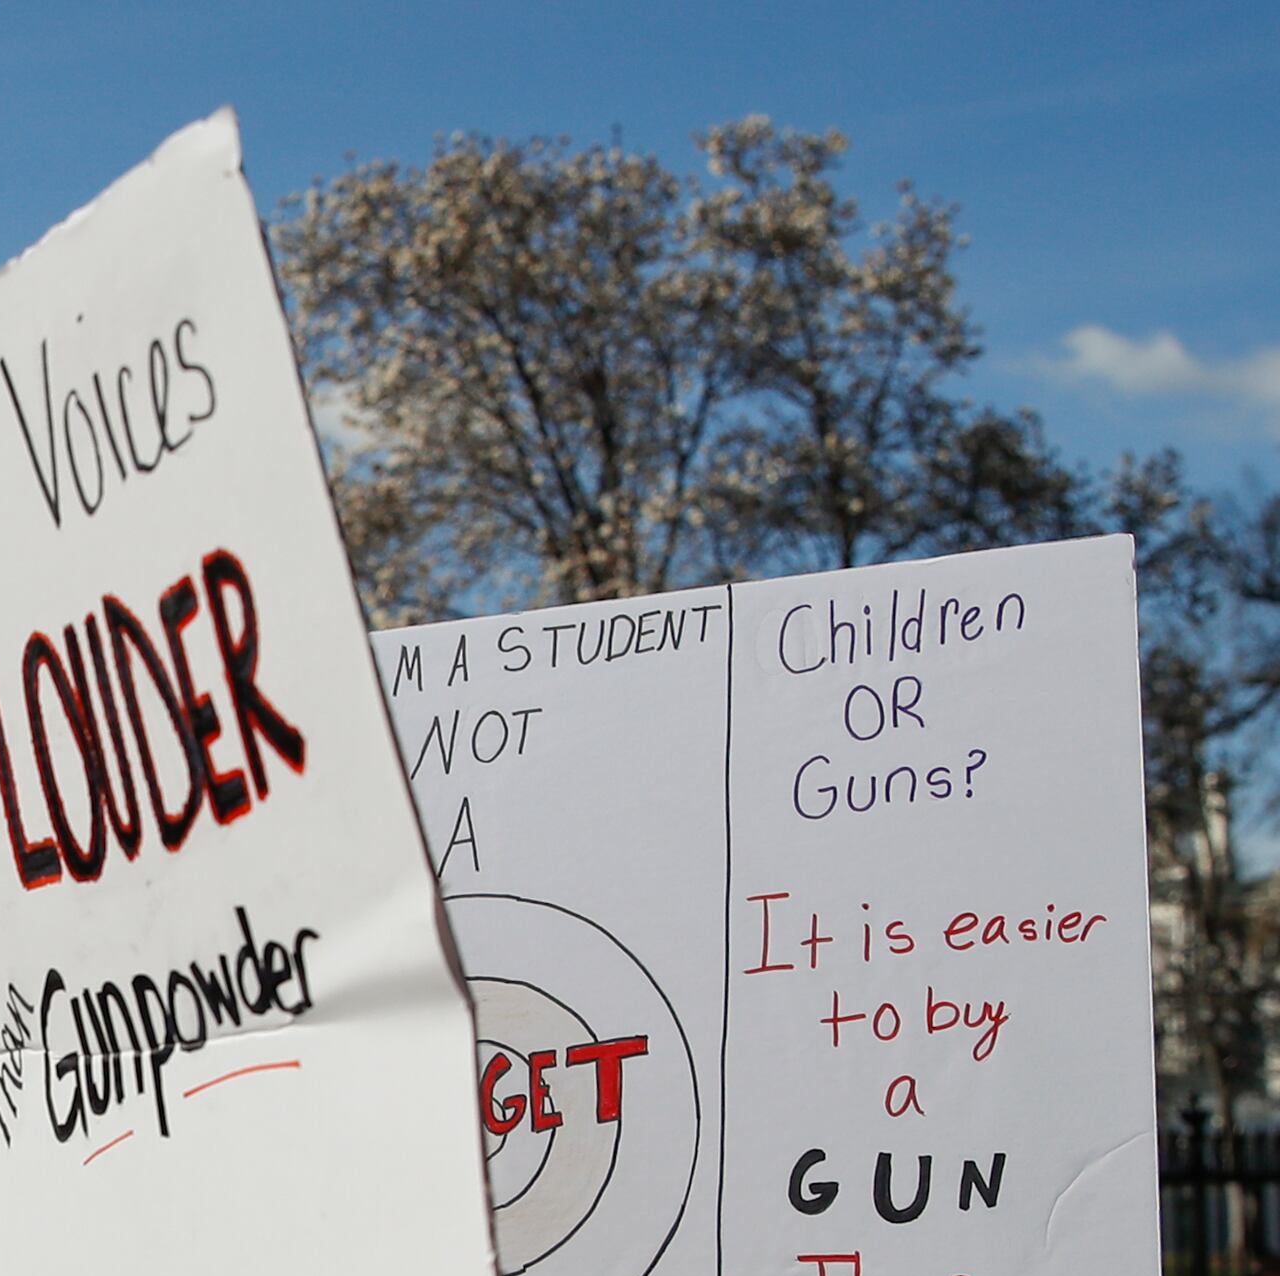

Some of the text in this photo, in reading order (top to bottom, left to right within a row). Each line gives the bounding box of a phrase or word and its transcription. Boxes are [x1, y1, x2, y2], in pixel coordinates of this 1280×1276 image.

[0, 314, 215, 529] Voices
[447, 634, 469, 687] A
[498, 604, 723, 673] STUDENT
[777, 588, 1025, 674] Children
[410, 707, 543, 780] NOT
[844, 676, 926, 741] OR
[793, 749, 988, 819] Guns?
[438, 797, 480, 878] A
[743, 892, 1107, 974] It is easier
[40, 906, 319, 1142] Gunpowder
[820, 985, 1011, 1062] to buy
[885, 1073, 925, 1118] a
[788, 1148, 1007, 1224] GUN
